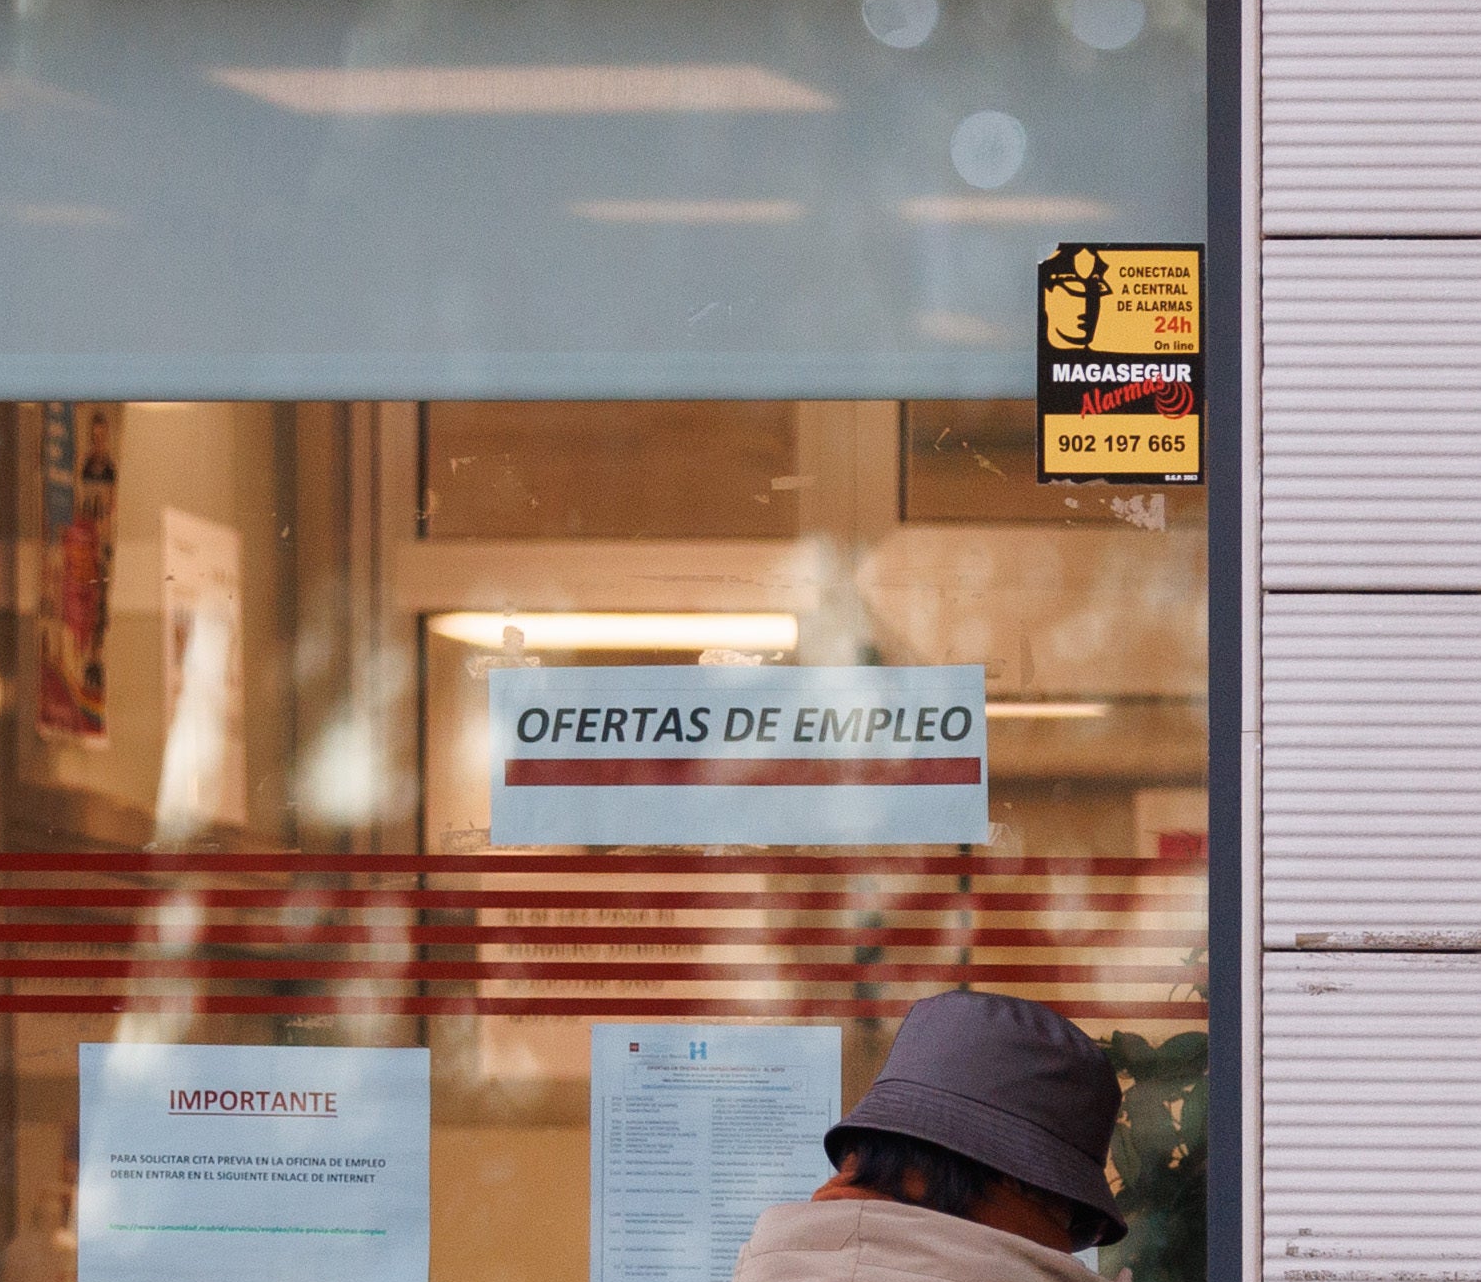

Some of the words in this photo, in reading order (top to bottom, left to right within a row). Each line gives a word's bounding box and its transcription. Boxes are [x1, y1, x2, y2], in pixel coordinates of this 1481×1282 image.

[1119, 267, 1190, 277] CONECTADA
[1122, 285, 1129, 294] A
[1133, 284, 1187, 294] CENTRAL
[1117, 301, 1132, 311] DE
[1136, 301, 1192, 311] ALARMAS
[1154, 317, 1191, 333] 24h
[1154, 341, 1170, 351] On
[1173, 341, 1193, 350] line
[1053, 364, 1191, 382] MAGASEGUR
[1080, 373, 1165, 419] Alarmas
[1059, 435, 1096, 452] 902
[1105, 435, 1141, 452] 197
[1148, 435, 1185, 452] 665
[516, 706, 711, 743] OFERTAS
[723, 706, 778, 742] DE
[793, 706, 973, 742] EMPLEO
[169, 1090, 337, 1113] IMPORTANTE
[111, 1154, 137, 1163] PARA
[140, 1155, 190, 1164] SOLICITAR
[192, 1155, 215, 1164] CITA
[217, 1156, 253, 1165] PREVIA
[256, 1157, 269, 1165] EN
[272, 1157, 284, 1166] LA
[286, 1157, 326, 1167] OFICINA
[329, 1158, 342, 1167] DE
[345, 1158, 385, 1168] EMPLEO
[111, 1170, 142, 1179] DEBEN
[146, 1170, 185, 1180] ENTRAR
[188, 1171, 201, 1180] EN
[204, 1171, 214, 1180] EL
[217, 1171, 269, 1181] SIGUIENTE
[272, 1173, 308, 1182] ENLACE
[311, 1173, 324, 1182] DE
[327, 1174, 375, 1183] INTERNET
